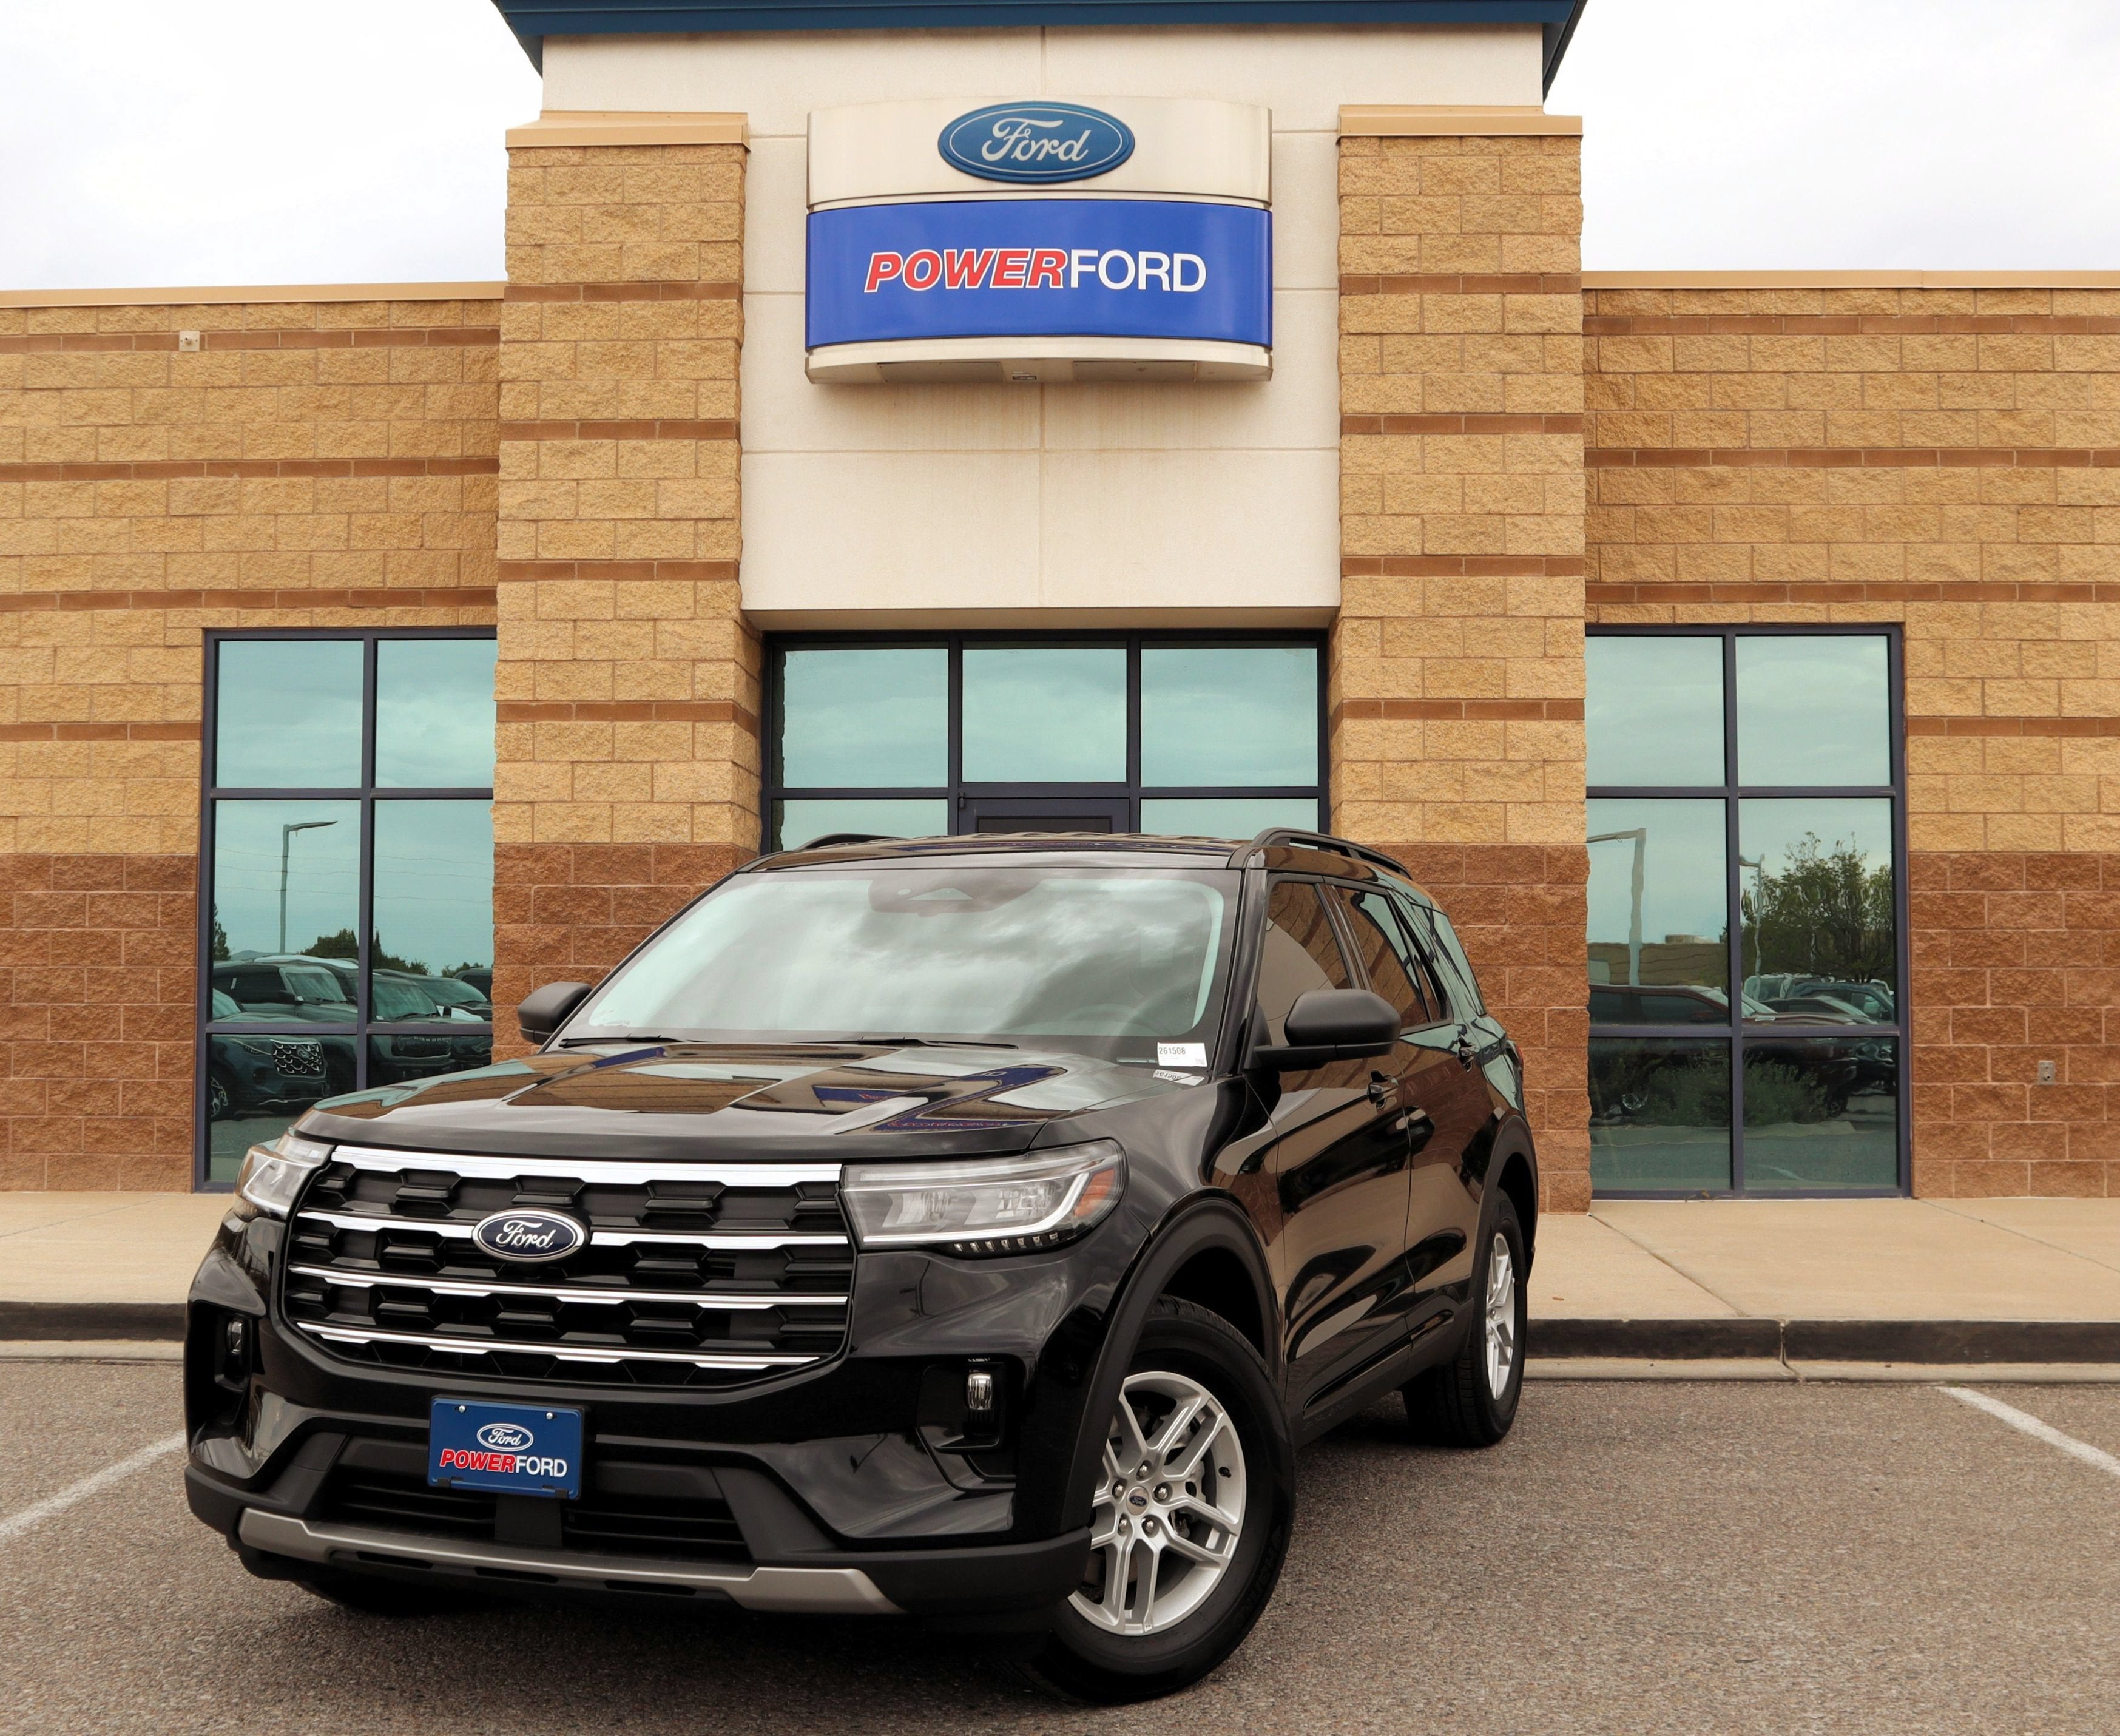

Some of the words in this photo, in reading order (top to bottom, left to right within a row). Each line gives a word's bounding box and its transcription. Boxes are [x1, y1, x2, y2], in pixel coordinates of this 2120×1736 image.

[981, 117, 1091, 163] Ford
[864, 248, 1207, 293] POWERFORD
[495, 1220, 556, 1249] Ford
[488, 1428, 522, 1446] Ford
[439, 1448, 568, 1478] POWERFORD
